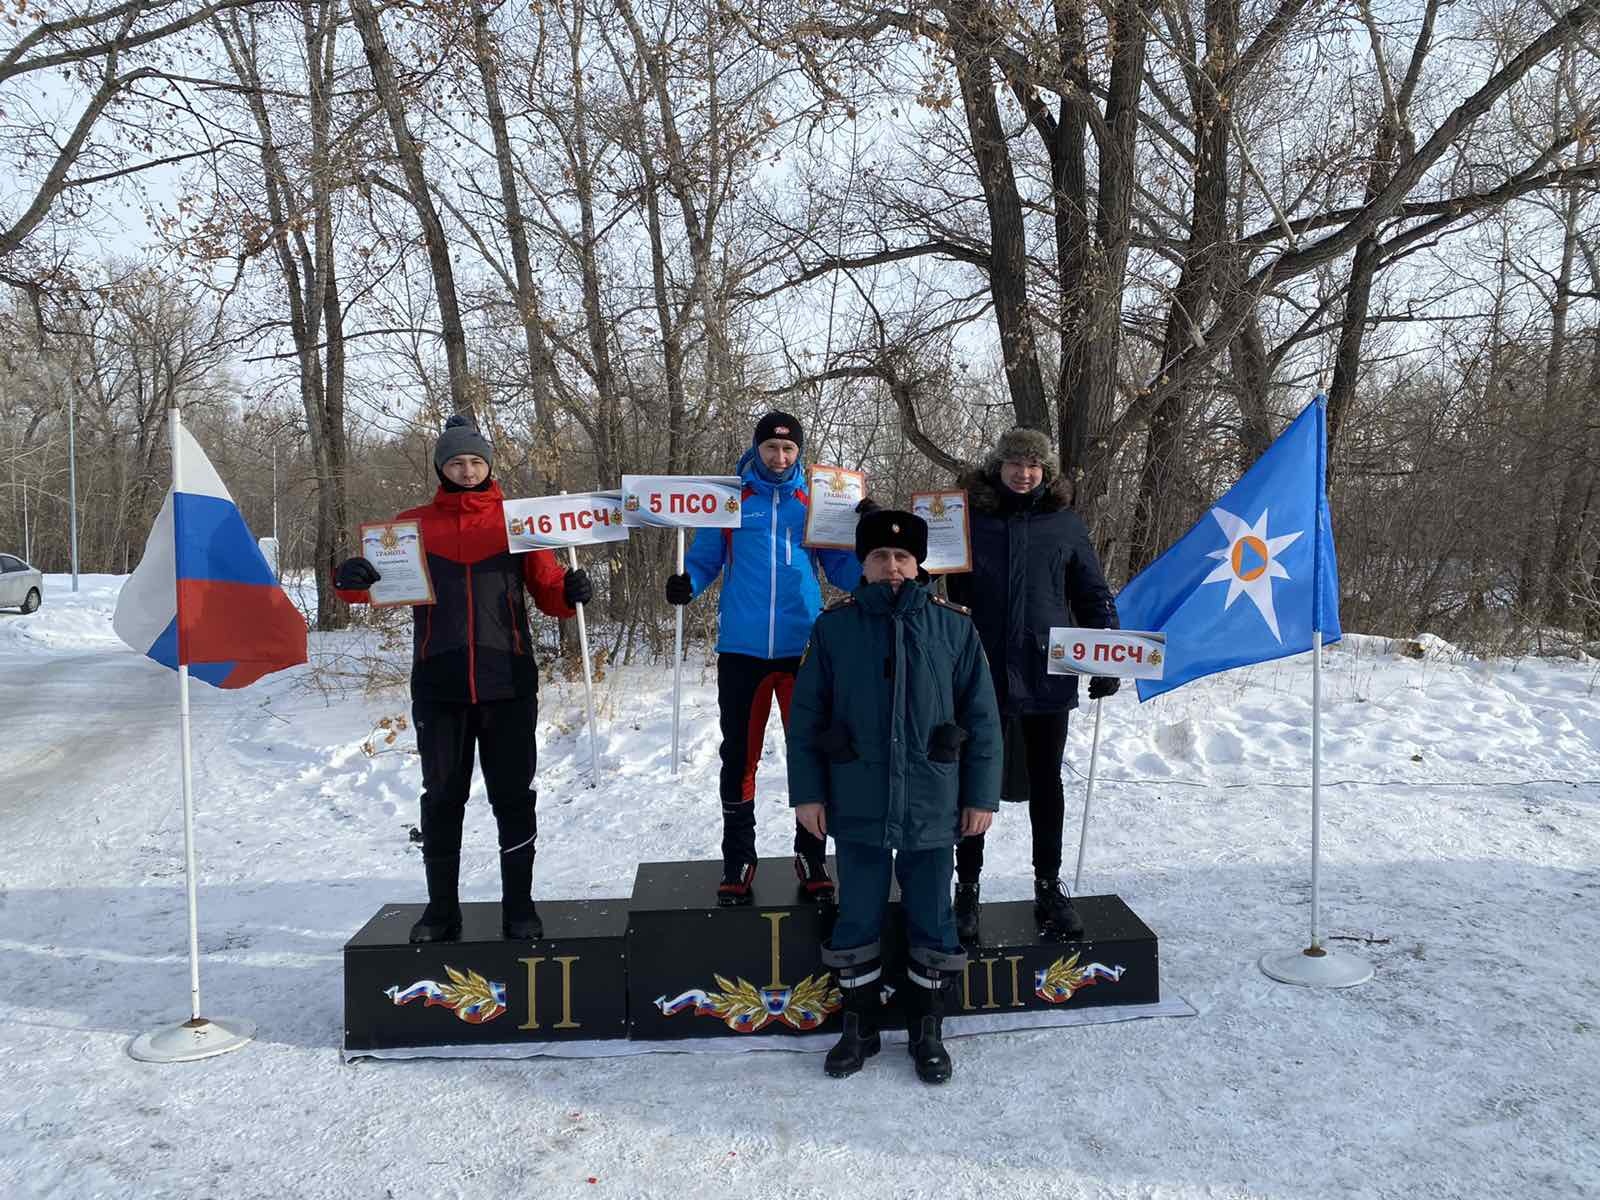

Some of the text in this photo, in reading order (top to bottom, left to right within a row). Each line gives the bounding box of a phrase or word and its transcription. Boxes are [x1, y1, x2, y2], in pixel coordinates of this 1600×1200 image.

[650, 493, 717, 513] 5 ПСО
[524, 507, 610, 535] 16 ПСЧ
[375, 549, 407, 558] ГРАМОТА
[1072, 642, 1143, 664] 9 ПСЧ
[518, 956, 581, 1030] II
[963, 955, 1025, 1010] III
